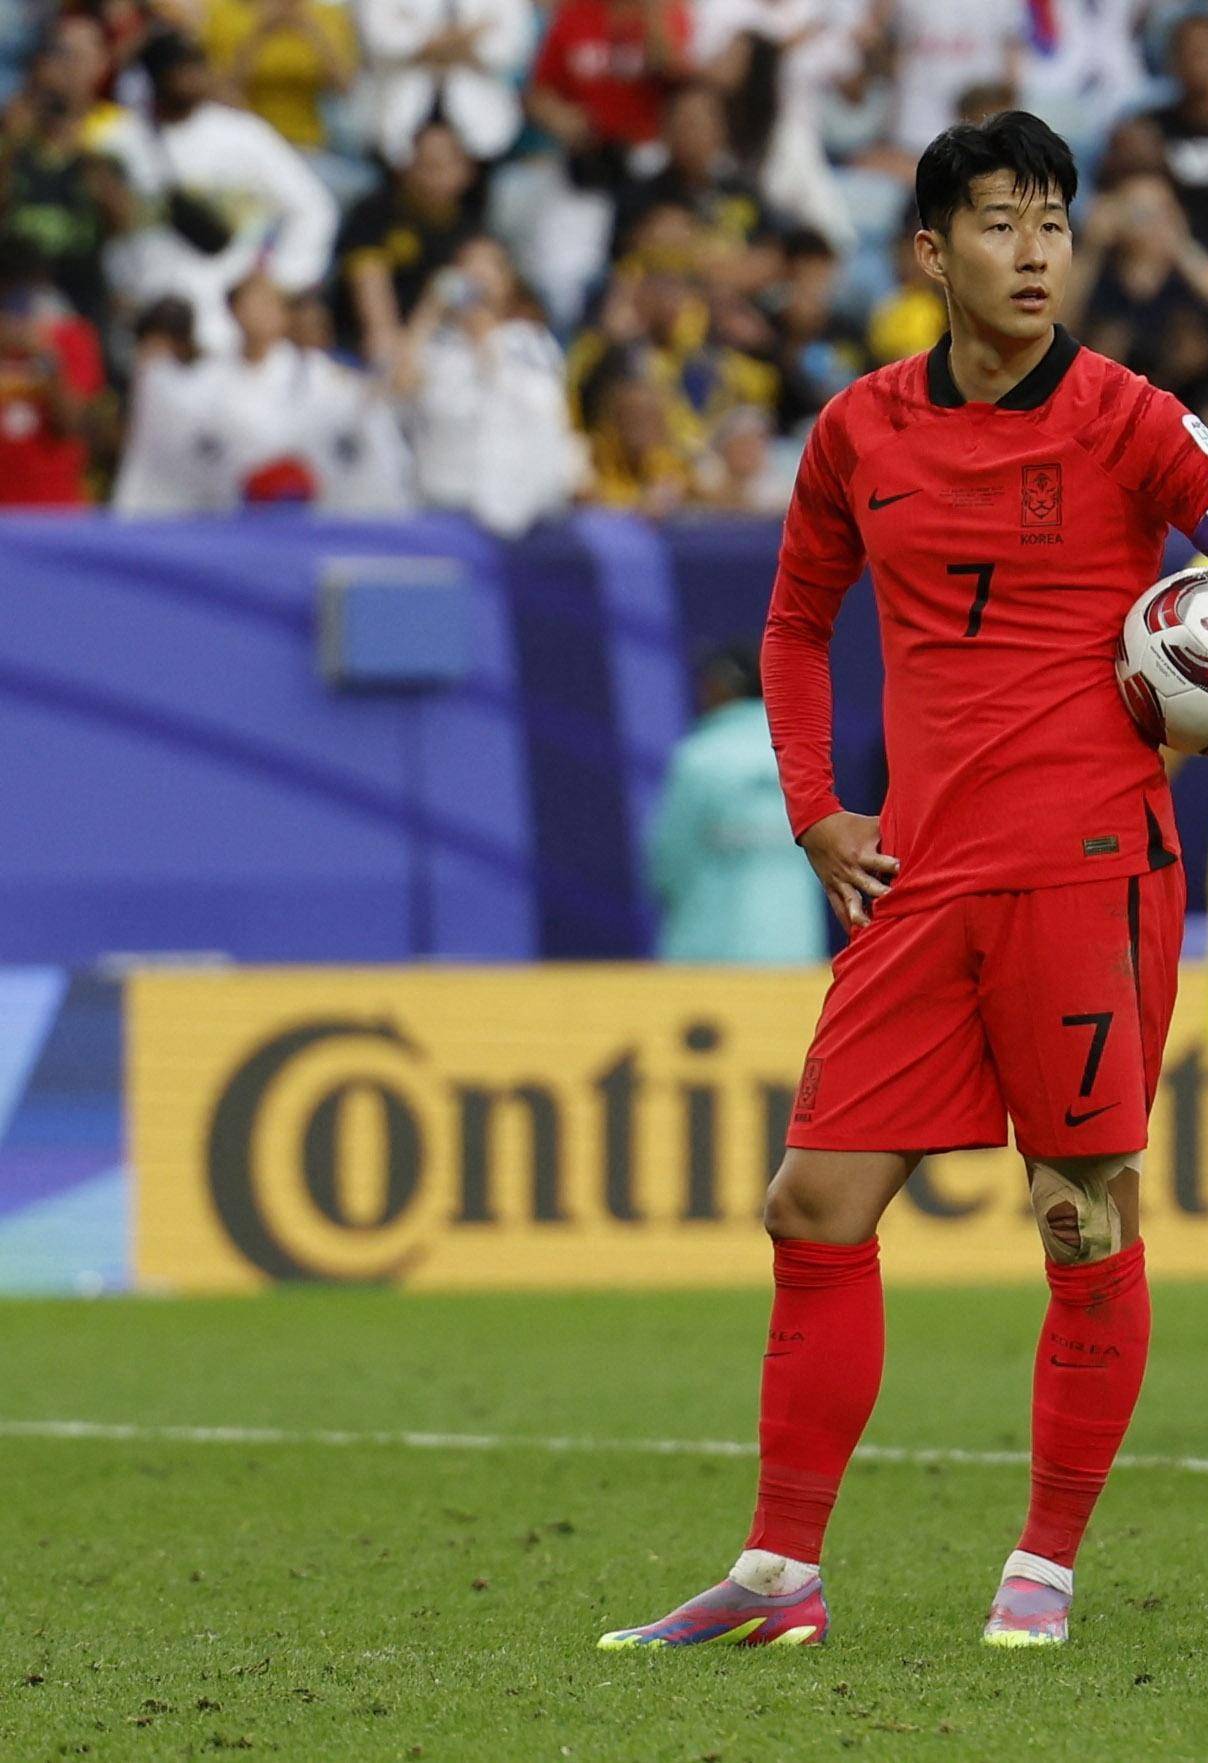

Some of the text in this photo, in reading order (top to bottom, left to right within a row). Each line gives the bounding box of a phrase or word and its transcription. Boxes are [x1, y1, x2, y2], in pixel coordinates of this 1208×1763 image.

[1020, 533, 1064, 544] KOREA
[946, 563, 995, 638] 7
[1062, 1011, 1113, 1097] 7
